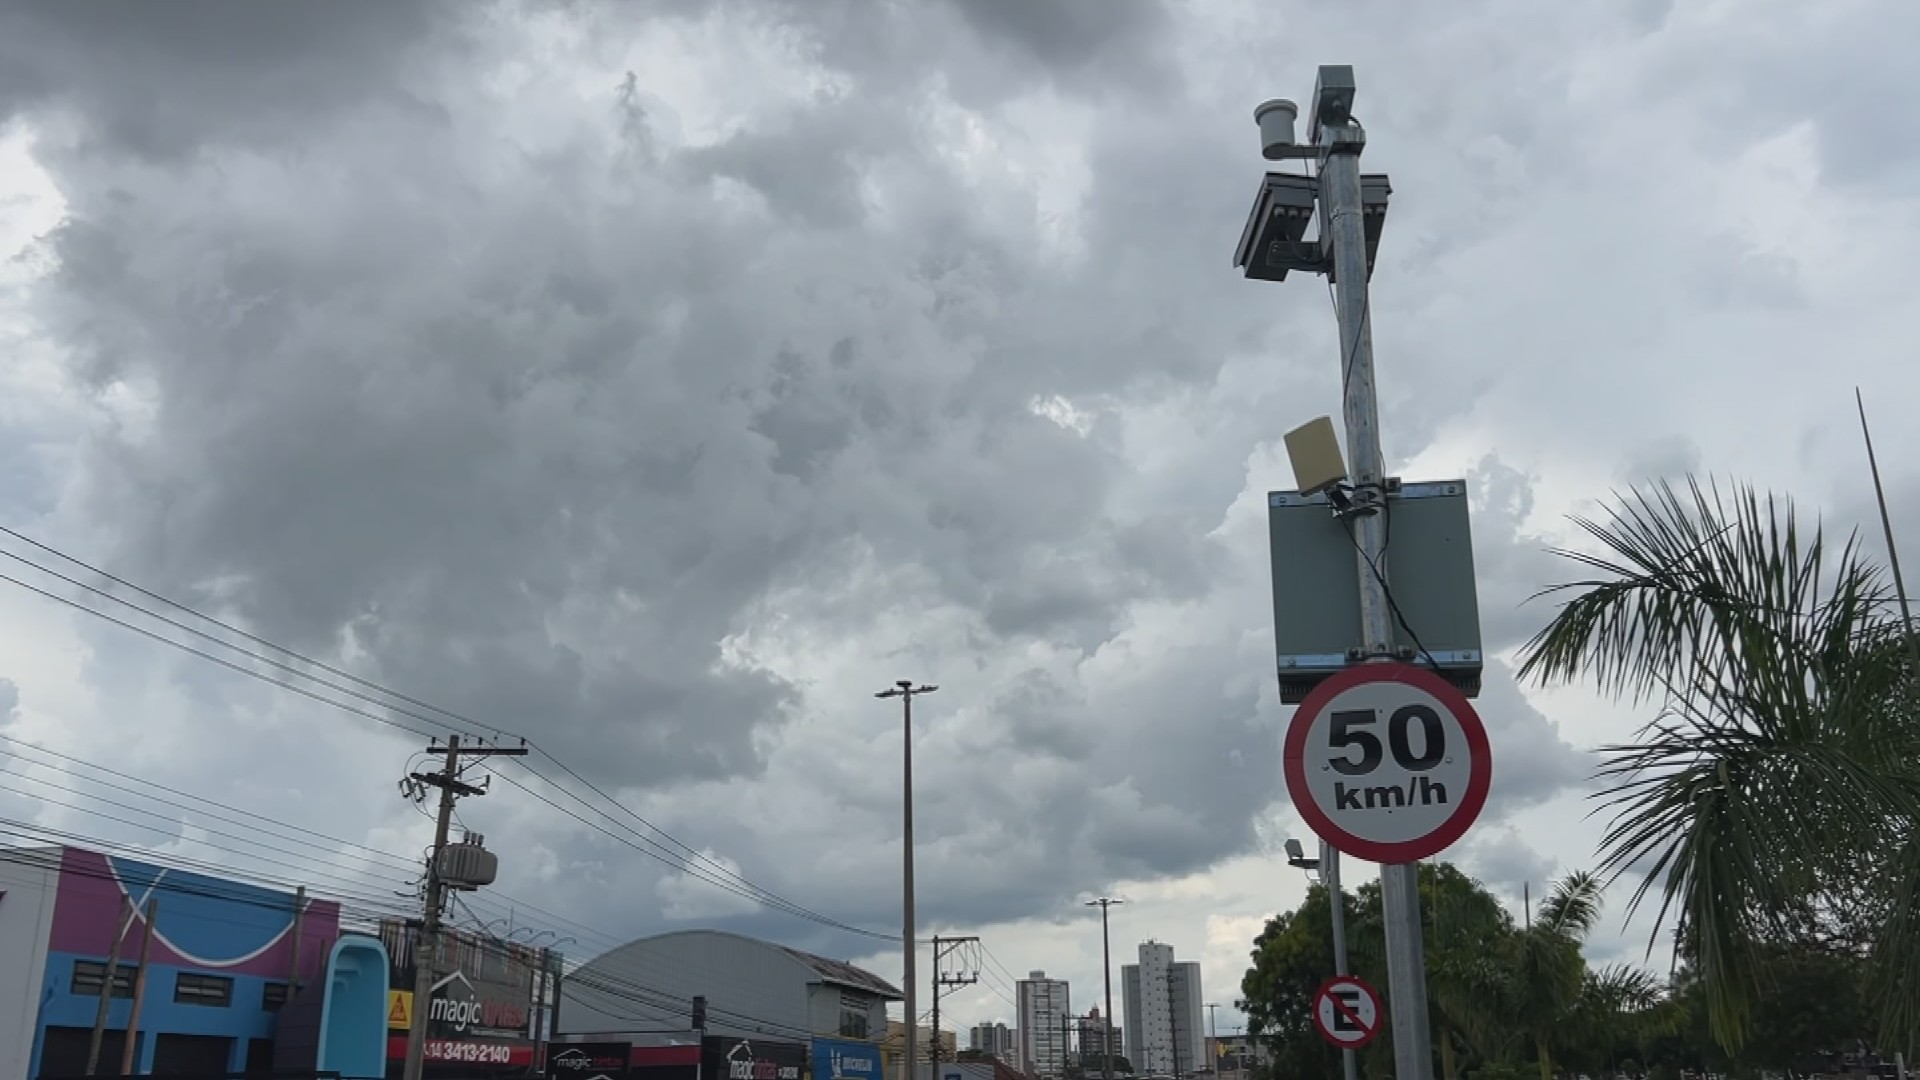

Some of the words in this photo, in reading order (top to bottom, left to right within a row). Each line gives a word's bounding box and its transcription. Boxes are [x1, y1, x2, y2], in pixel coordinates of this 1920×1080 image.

[1328, 704, 1445, 775] 50
[1334, 777, 1447, 810] km/h
[430, 994, 481, 1031] magic
[483, 997, 523, 1028] tintas
[431, 1042, 441, 1057] 14
[557, 1055, 592, 1070] magic
[730, 1057, 754, 1080] magic
